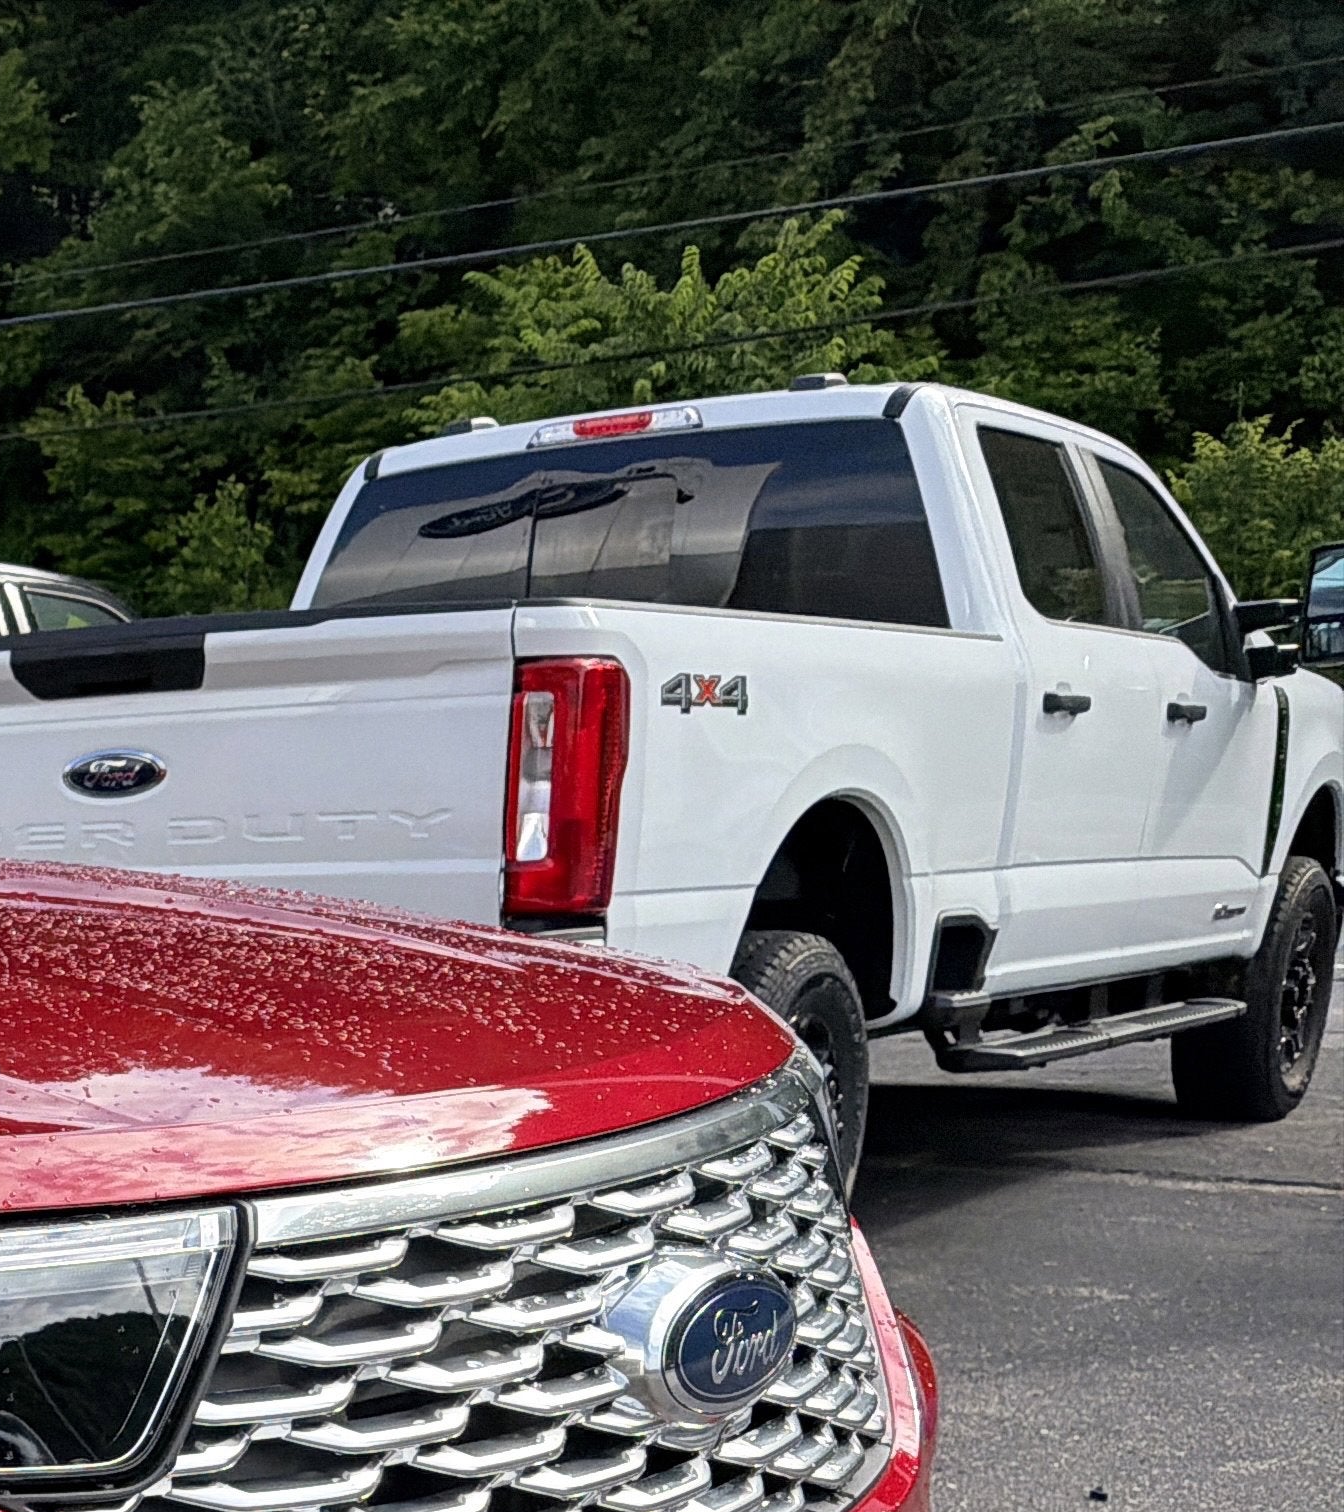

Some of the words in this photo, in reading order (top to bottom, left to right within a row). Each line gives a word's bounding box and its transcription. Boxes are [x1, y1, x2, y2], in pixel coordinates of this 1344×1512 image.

[83, 759, 144, 788] Ford
[166, 808, 453, 846] DUTY
[712, 1299, 778, 1384] Ford
